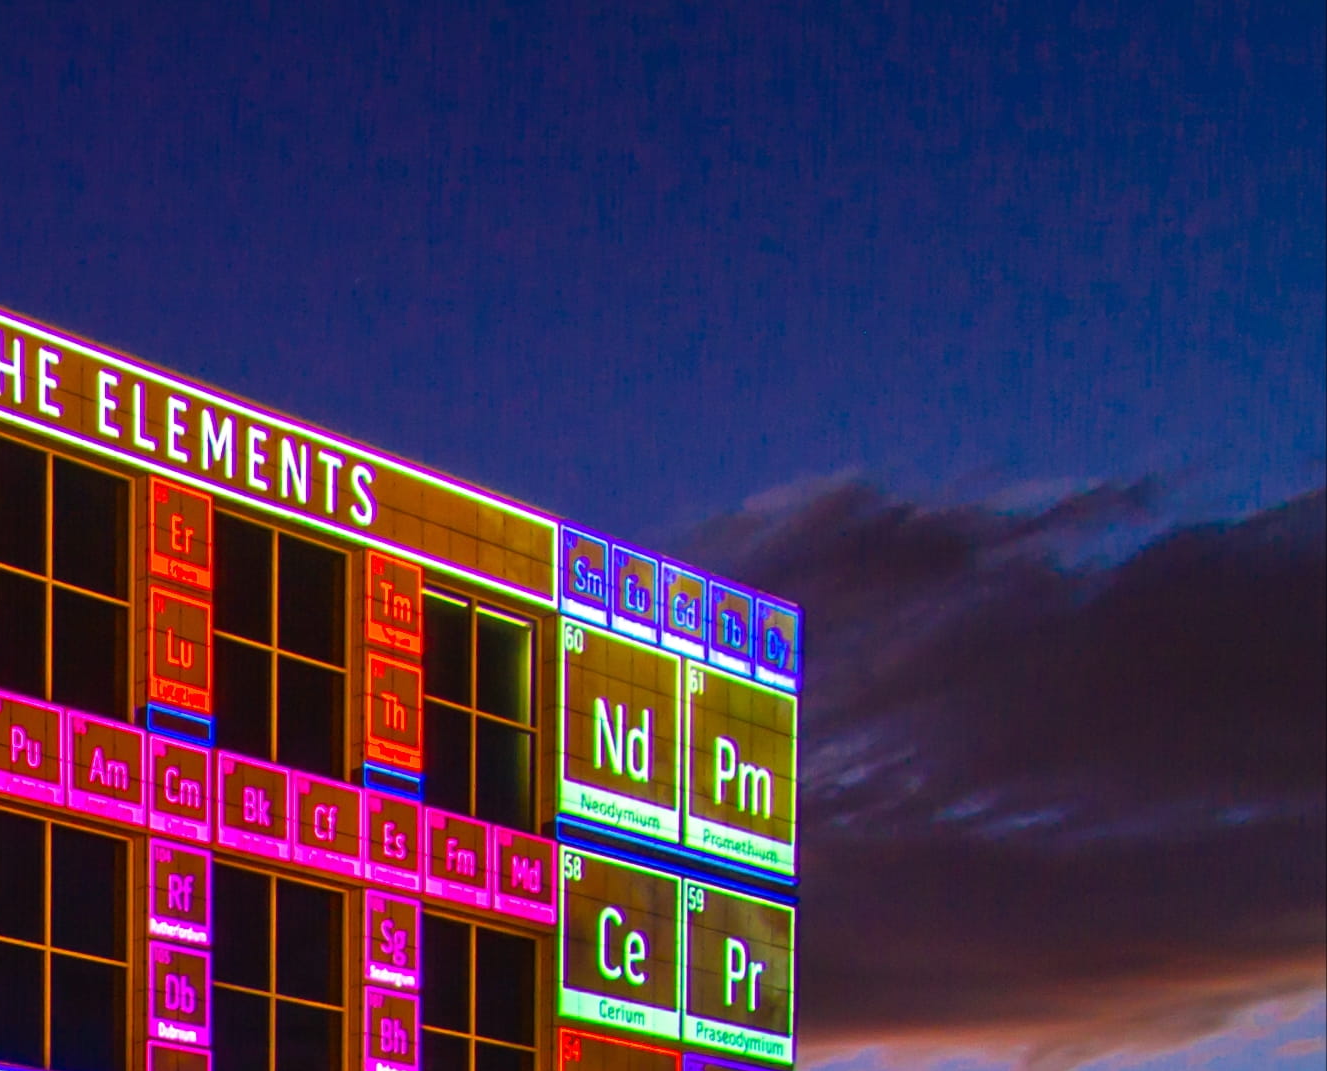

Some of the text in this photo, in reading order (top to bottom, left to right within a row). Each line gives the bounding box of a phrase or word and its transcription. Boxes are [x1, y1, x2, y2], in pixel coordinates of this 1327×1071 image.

[97, 370, 374, 526] ELEMENTS
[565, 624, 583, 654] 60
[11, 726, 41, 769] Pu
[594, 697, 650, 783] Nd
[89, 748, 128, 791] Am
[714, 737, 771, 819] Pm
[581, 794, 660, 830] Neodymium
[598, 907, 646, 986] Ce
[724, 937, 764, 1012] Pr
[599, 1001, 645, 1027] Cerium
[696, 1021, 784, 1056] Praseodymium
